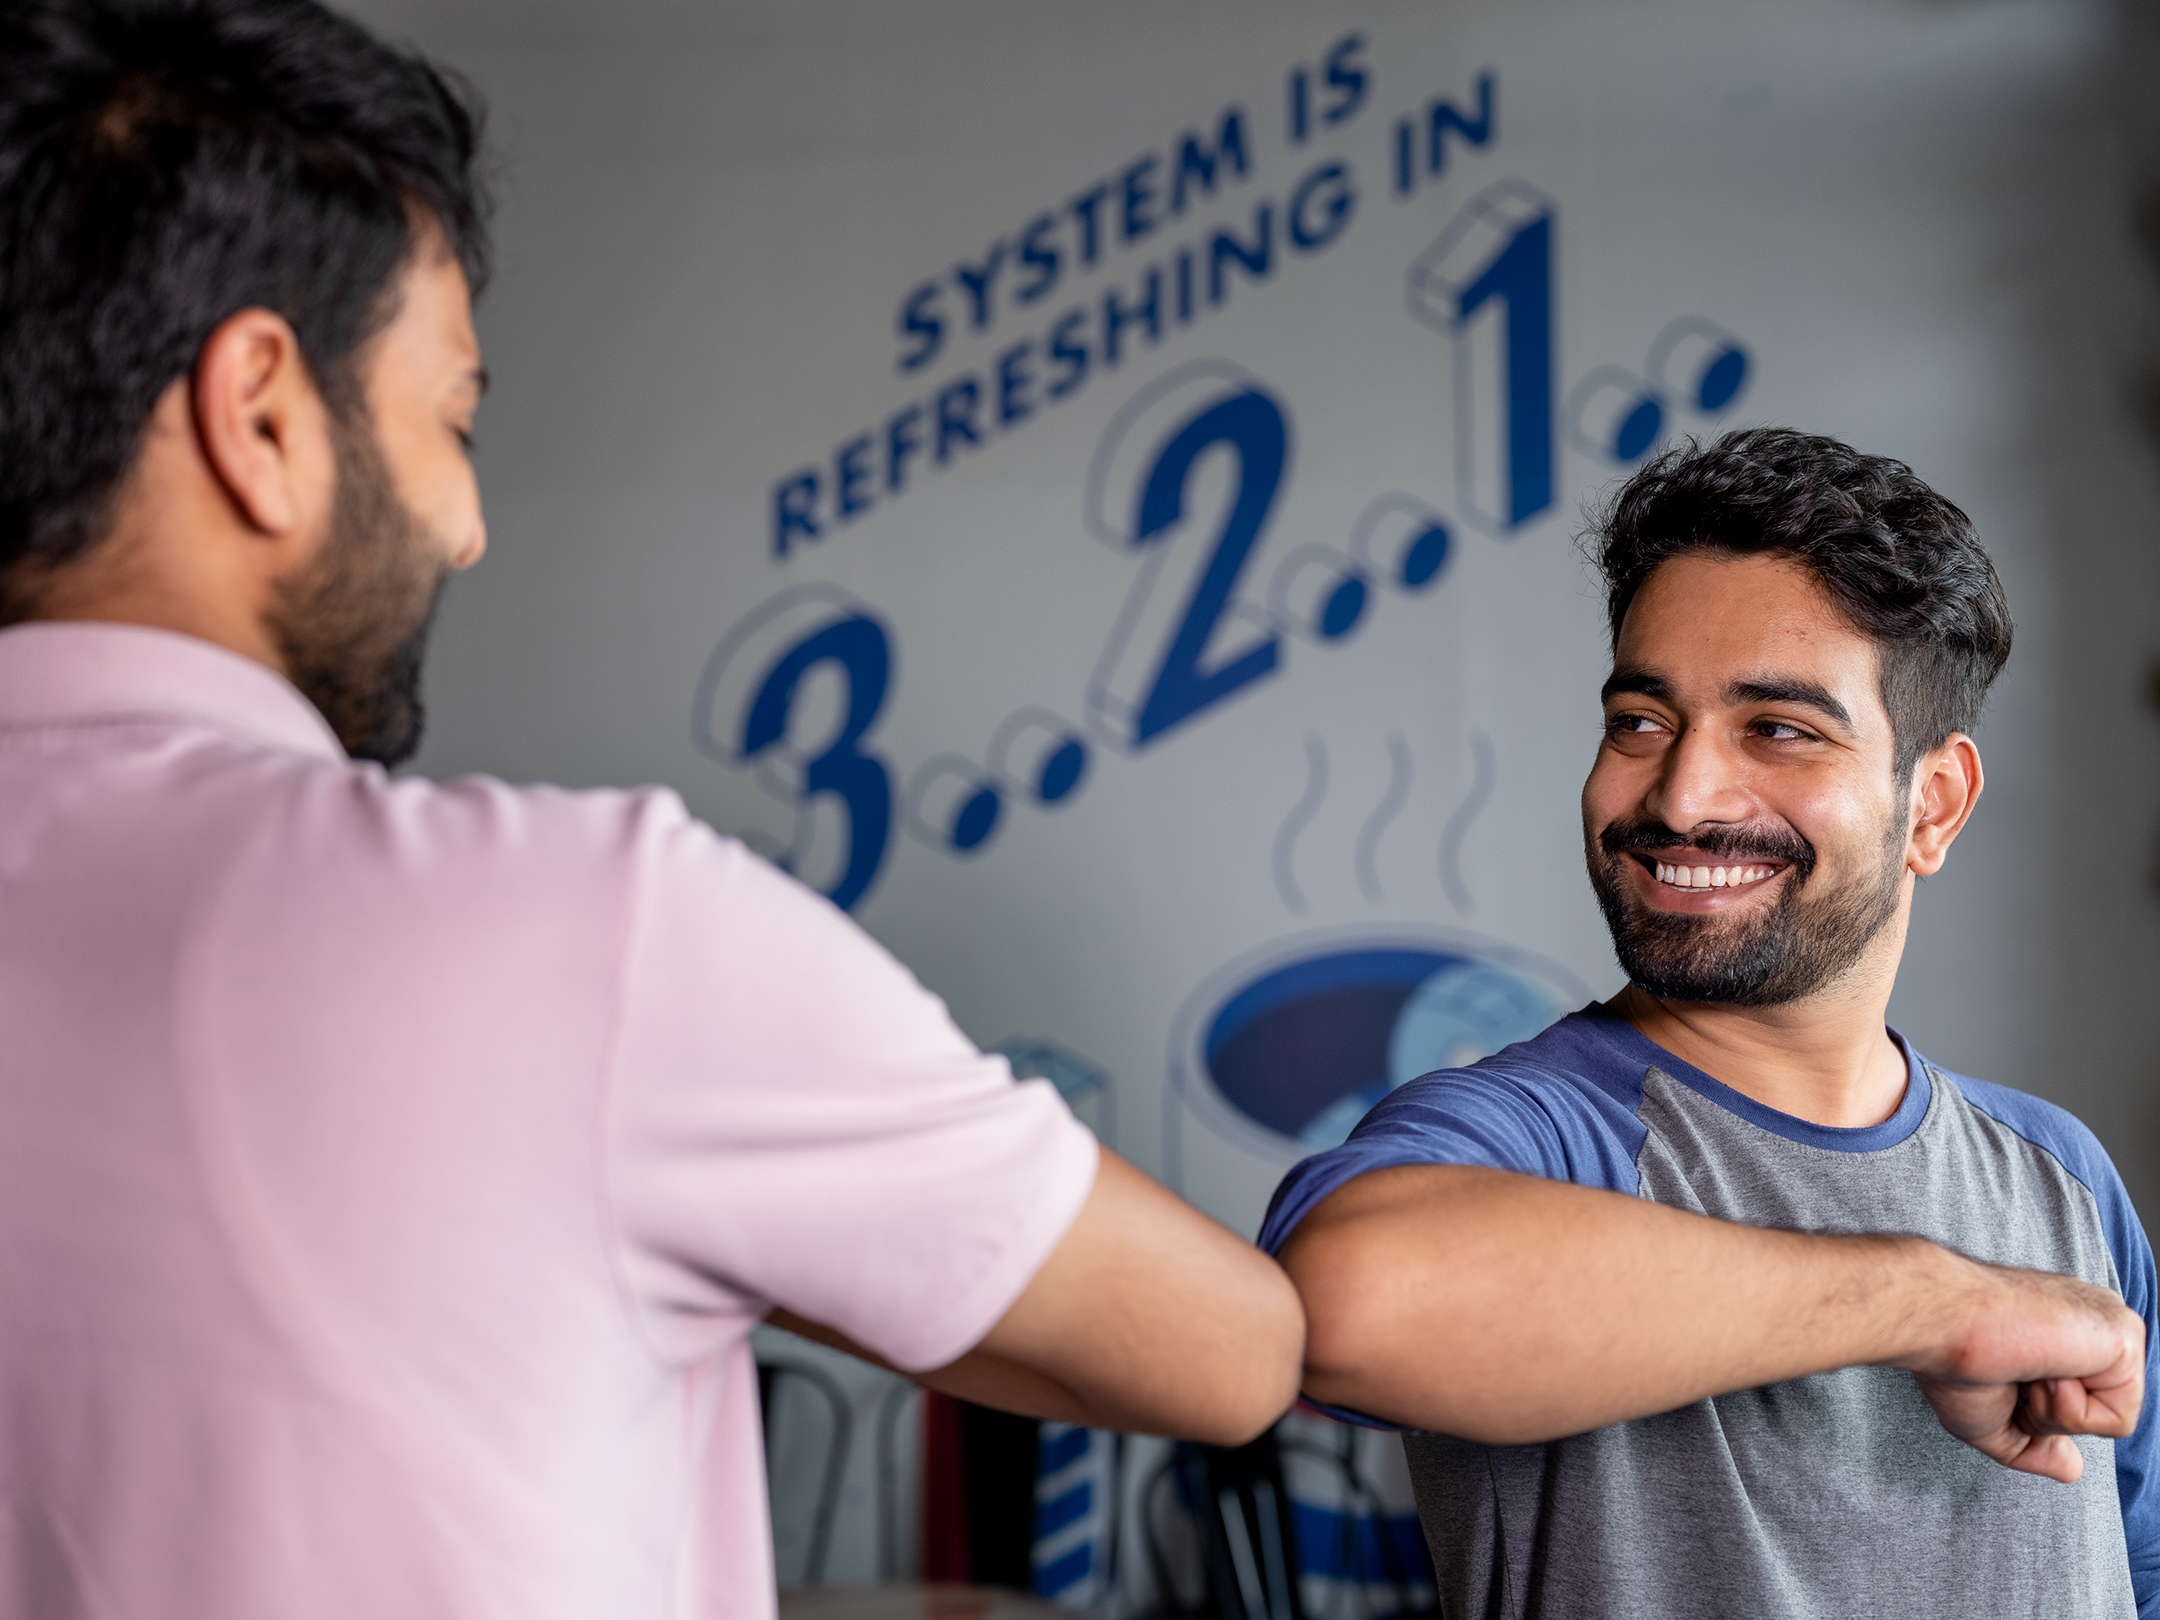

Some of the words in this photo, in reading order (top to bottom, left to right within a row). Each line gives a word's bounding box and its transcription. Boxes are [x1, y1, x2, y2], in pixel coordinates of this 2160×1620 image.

[768, 159, 1358, 562] REFRESHING
[1390, 67, 1498, 199] IN
[893, 107, 1250, 376] SYSTEM
[1286, 34, 1372, 145] IS
